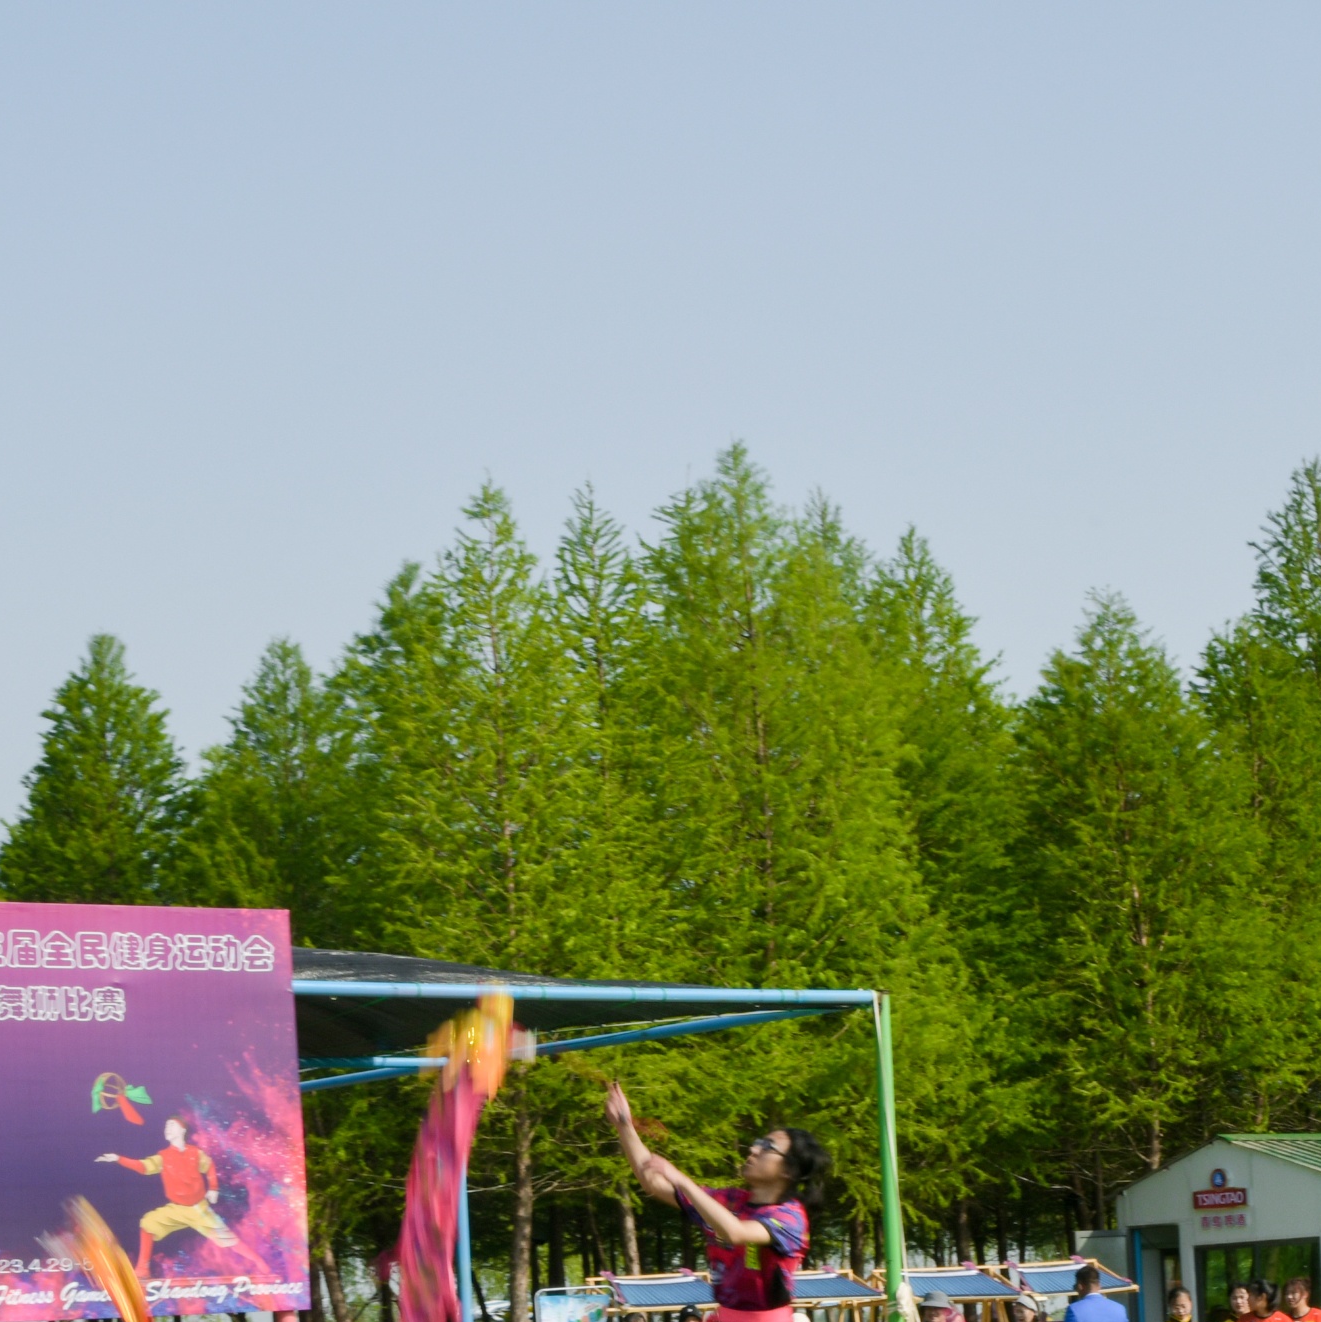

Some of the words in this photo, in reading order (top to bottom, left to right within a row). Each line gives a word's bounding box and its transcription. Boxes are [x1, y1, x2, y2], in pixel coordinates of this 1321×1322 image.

[1196, 1191, 1244, 1206] TSINGTAO
[144, 1279, 228, 1304] Shandong
[231, 1275, 304, 1298] Province
